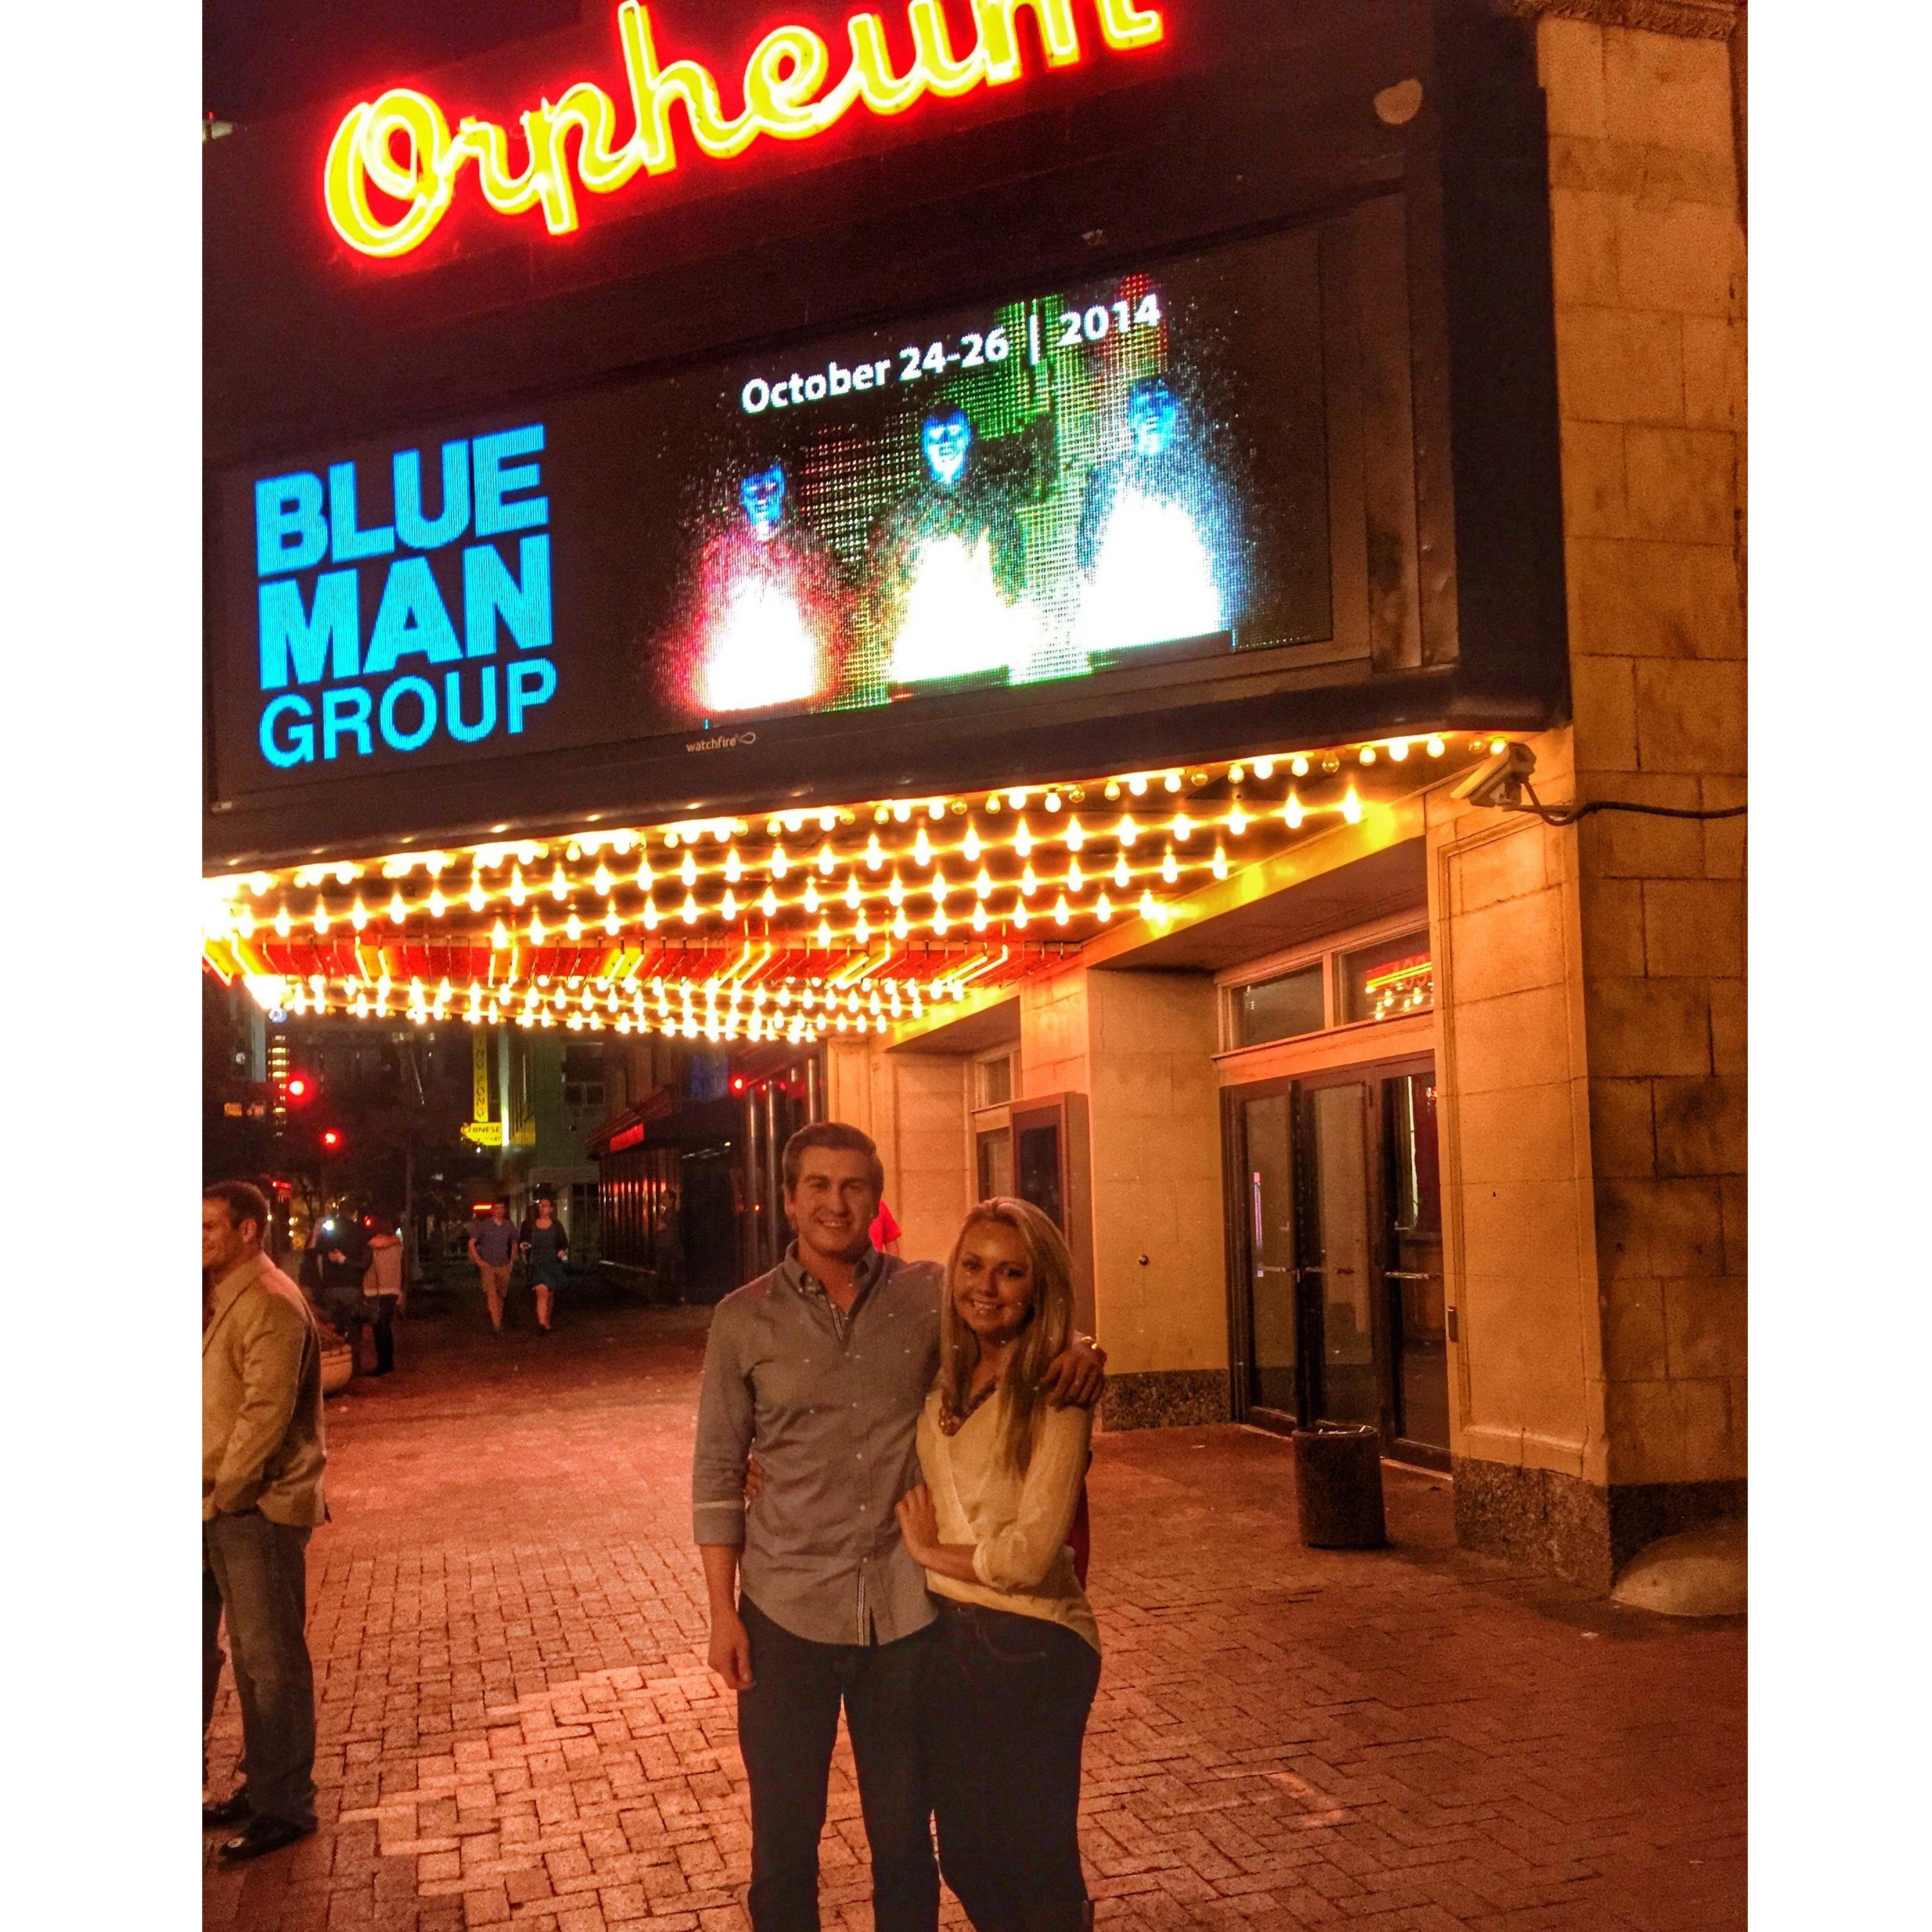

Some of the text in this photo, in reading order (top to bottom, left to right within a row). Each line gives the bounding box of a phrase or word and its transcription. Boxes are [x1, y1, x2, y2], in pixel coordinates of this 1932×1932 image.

[324, 0, 1163, 256] Orpheum
[742, 359, 891, 413] October
[899, 326, 1009, 381] 24-26
[1057, 294, 1161, 346] 2014
[255, 423, 549, 576] BLUE
[258, 533, 553, 690] MAN
[259, 658, 557, 769] GROUP
[686, 735, 737, 753] watchfire
